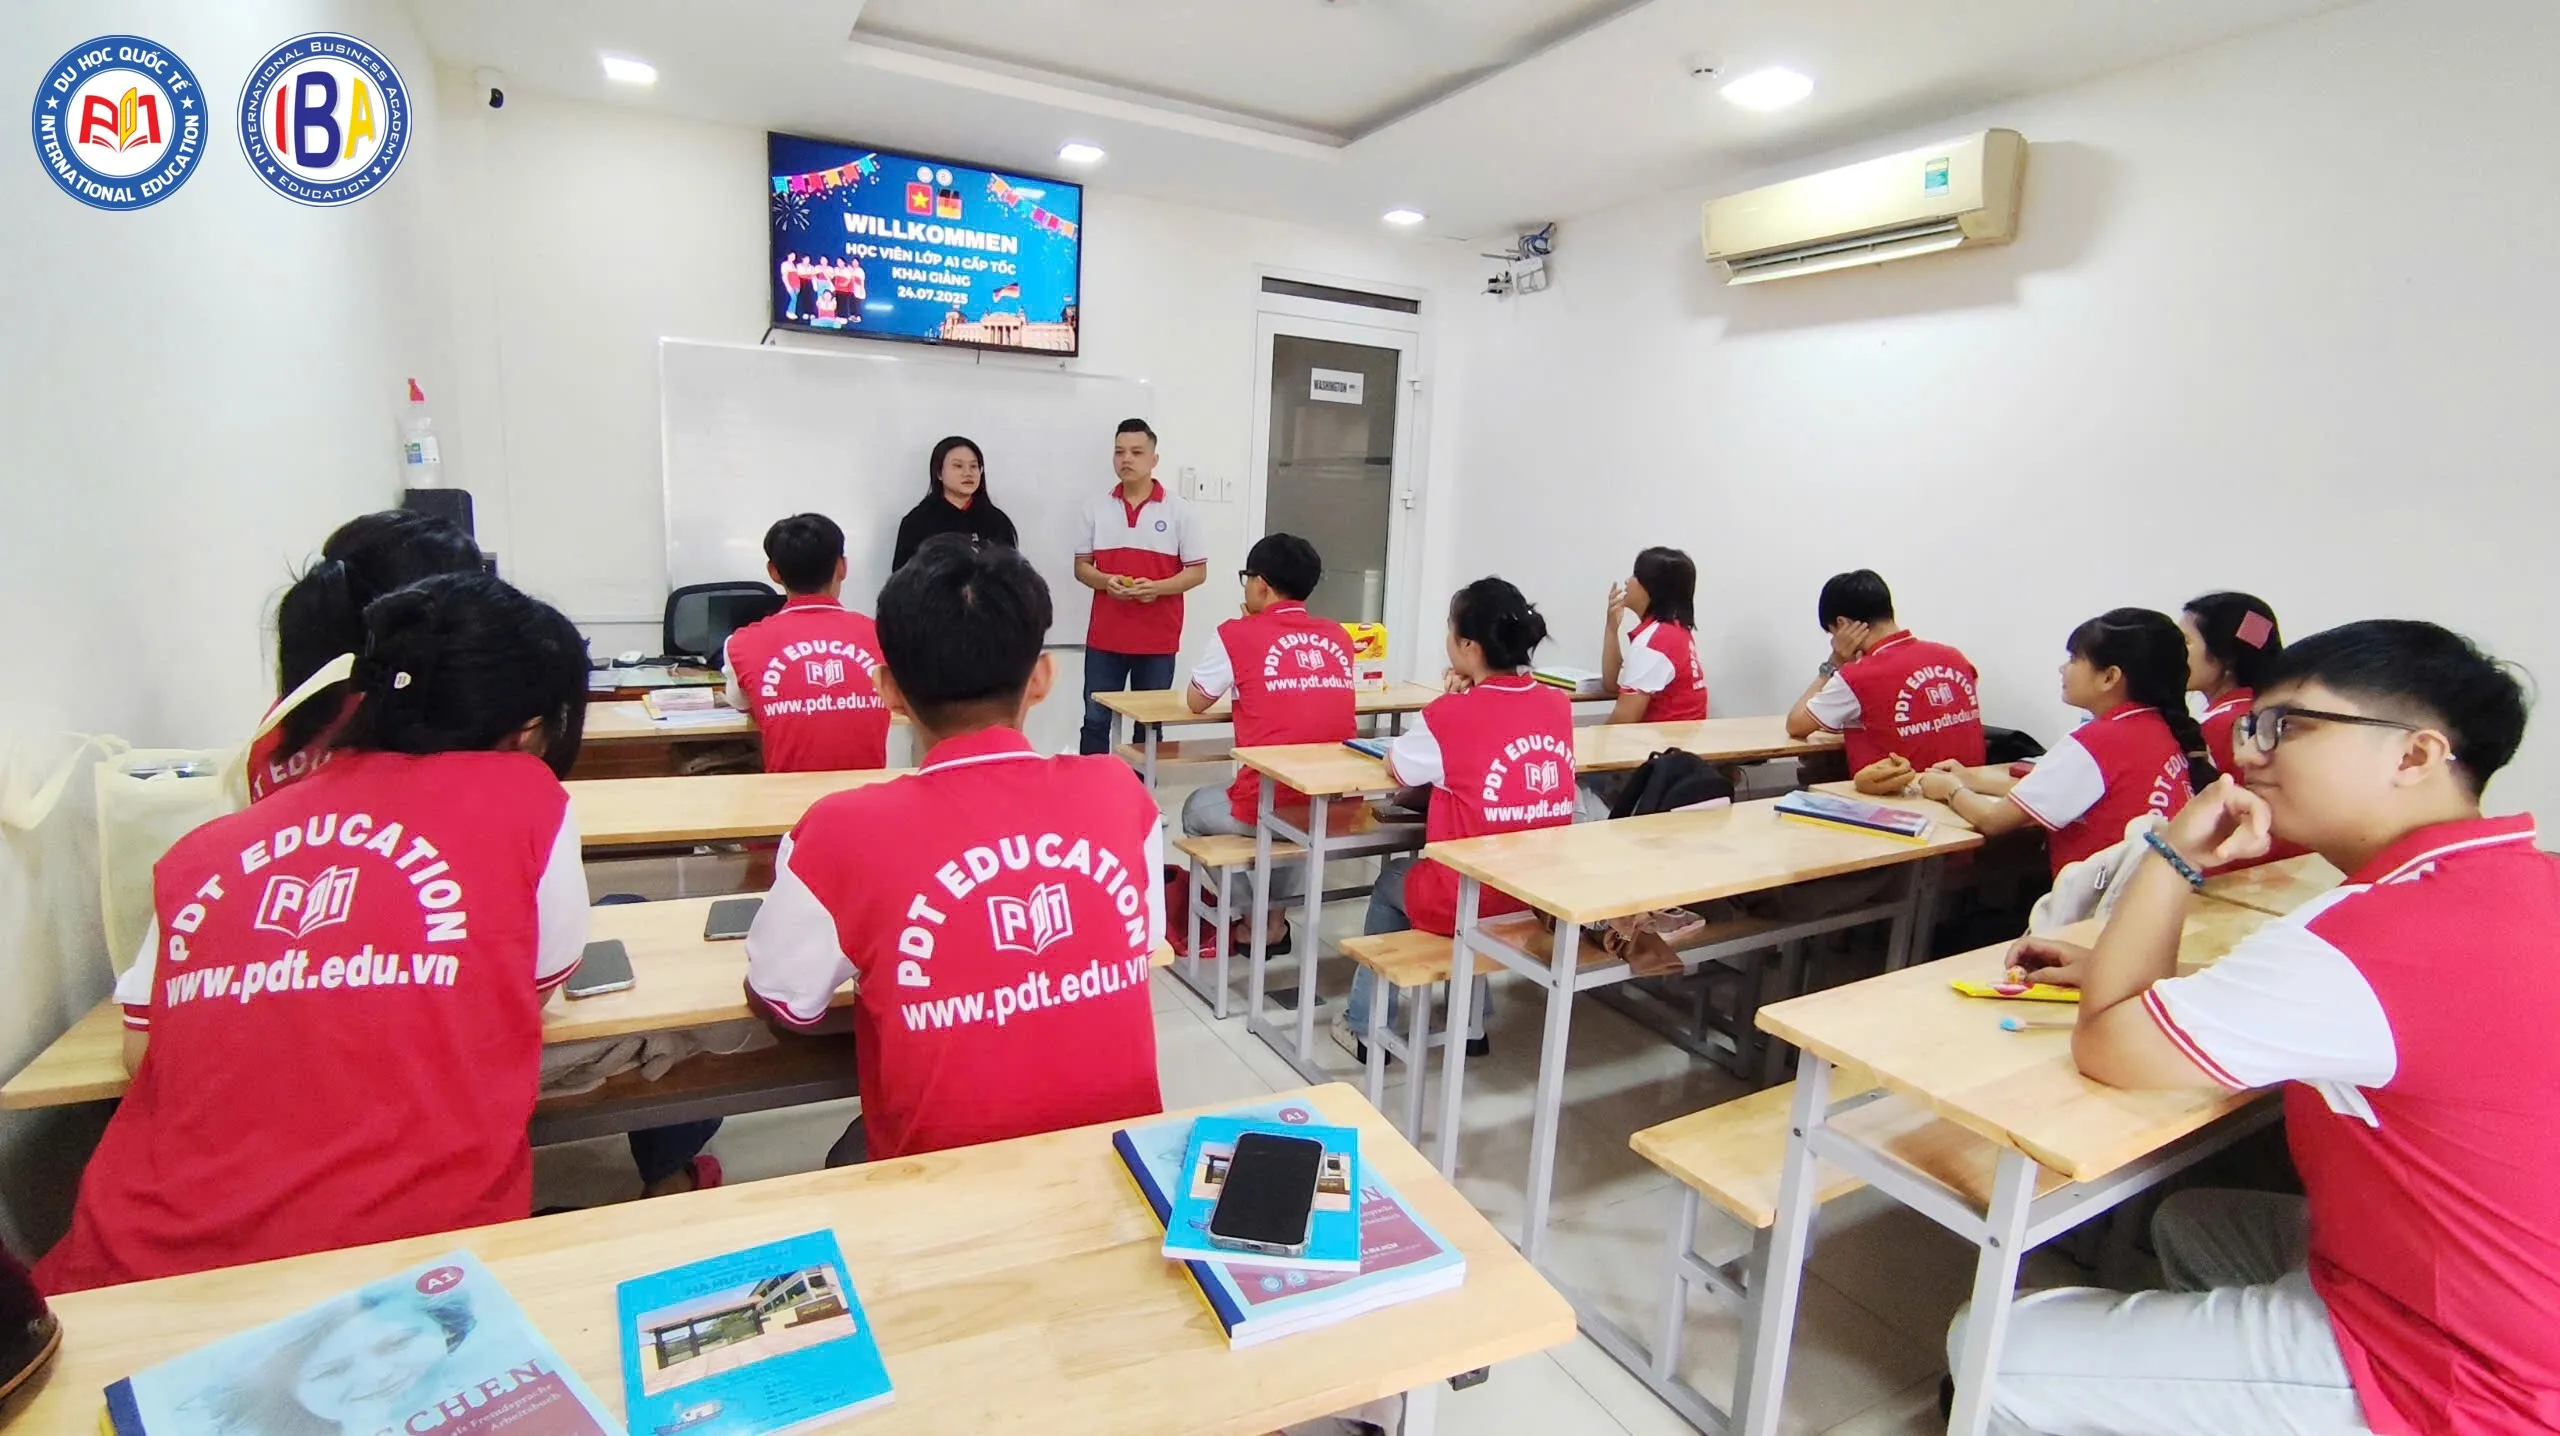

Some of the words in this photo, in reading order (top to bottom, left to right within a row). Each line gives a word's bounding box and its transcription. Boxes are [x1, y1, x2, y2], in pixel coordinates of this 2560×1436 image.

[843, 212, 1018, 255] WILLKOMMEN
[845, 242, 878, 258] HỌC
[879, 246, 913, 262] VIÊN
[915, 249, 943, 266] LỚP
[944, 256, 960, 269] A1
[892, 267, 927, 283] KHAI
[929, 270, 972, 288] GIẢNG
[897, 286, 969, 305] 24.07.2025
[761, 656, 788, 697] PDT
[783, 639, 877, 691] EDUCATI
[1264, 645, 1283, 677] PDT
[1277, 632, 1353, 678] EDUCATION
[1893, 689, 1912, 723] PDT
[1905, 665, 1978, 706] EDUCATION
[1482, 757, 1508, 802] PDT
[1504, 734, 1576, 781] EDUCATI
[168, 873, 226, 962] PDT
[240, 812, 468, 942] EDUCATION
[897, 893, 947, 988] PDT
[935, 833, 1146, 948] EDUCATION
[165, 944, 460, 1009] www.pdt.edu.vn
[901, 954, 1149, 1032] www.pdt.edu.vn
[425, 1271, 458, 1291] A1
[374, 1358, 548, 1436] CHEN
